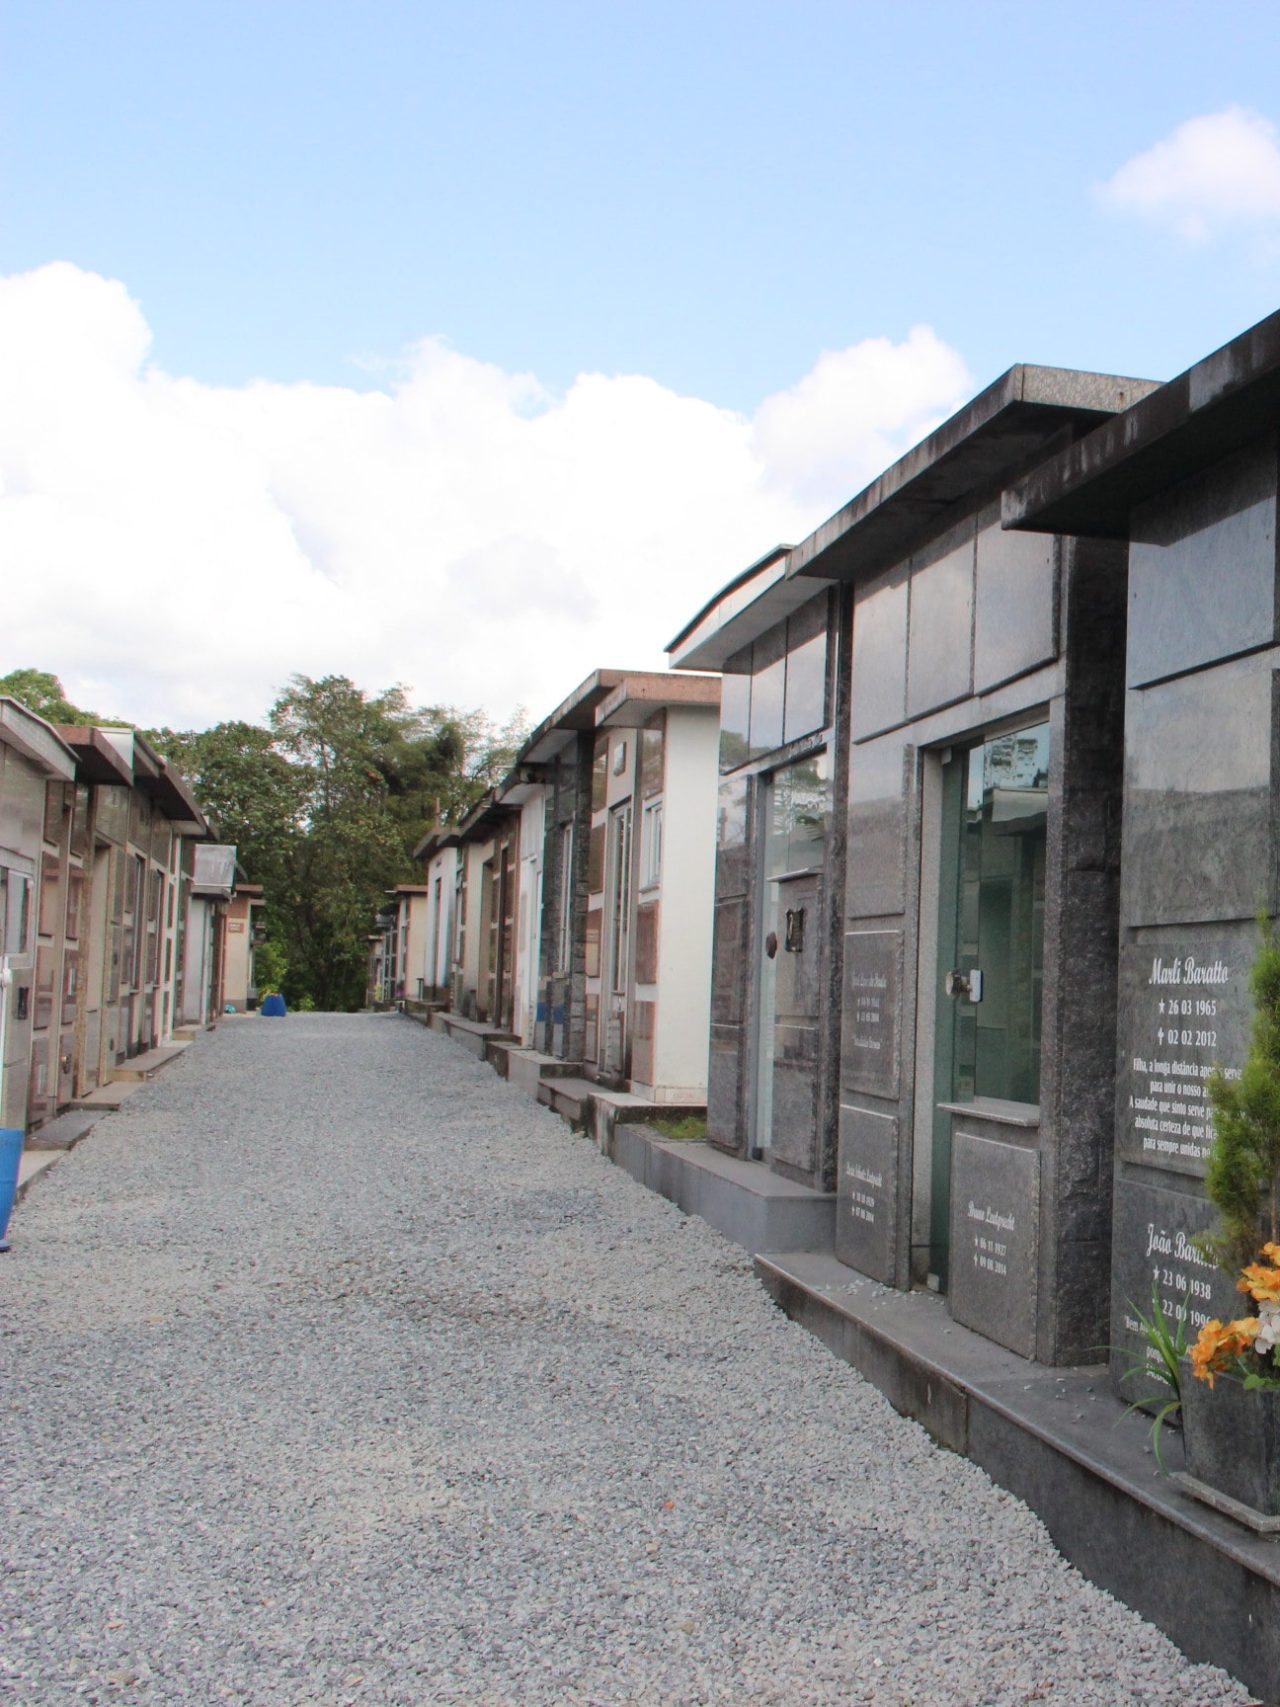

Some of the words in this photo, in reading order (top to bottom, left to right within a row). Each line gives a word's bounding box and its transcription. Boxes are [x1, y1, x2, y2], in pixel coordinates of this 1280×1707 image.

[1148, 957, 1182, 985] Marli
[1183, 956, 1229, 985] Baratto
[1168, 999, 1179, 1015] 26
[1181, 999, 1192, 1015] 03
[1195, 1000, 1217, 1016] 1965
[1168, 1029, 1179, 1045] 02
[1181, 1030, 1193, 1046] 02
[1195, 1031, 1217, 1047] 2012
[1149, 1062, 1153, 1072] a
[1150, 1080, 1163, 1094] para
[1177, 1085, 1182, 1094] o
[1183, 1084, 1201, 1097] nosso
[1129, 1095, 1134, 1108] A
[1135, 1096, 1158, 1111] saudade
[1159, 1100, 1171, 1115] que
[1172, 1100, 1187, 1115] sinto
[1188, 1104, 1205, 1118] serve
[1135, 1114, 1159, 1130] absoluta
[1159, 1120, 1181, 1135] certeza
[1182, 1121, 1191, 1136] de
[1192, 1126, 1204, 1140] que
[1144, 1137, 1156, 1150] para
[1157, 1139, 1179, 1156] sempre
[1180, 1142, 1201, 1157] unidas
[1146, 1223, 1172, 1256] João
[1162, 1269, 1173, 1286] 23
[1175, 1274, 1187, 1291] 06
[1190, 1279, 1212, 1300] 1938
[1162, 1299, 1173, 1317] 22
